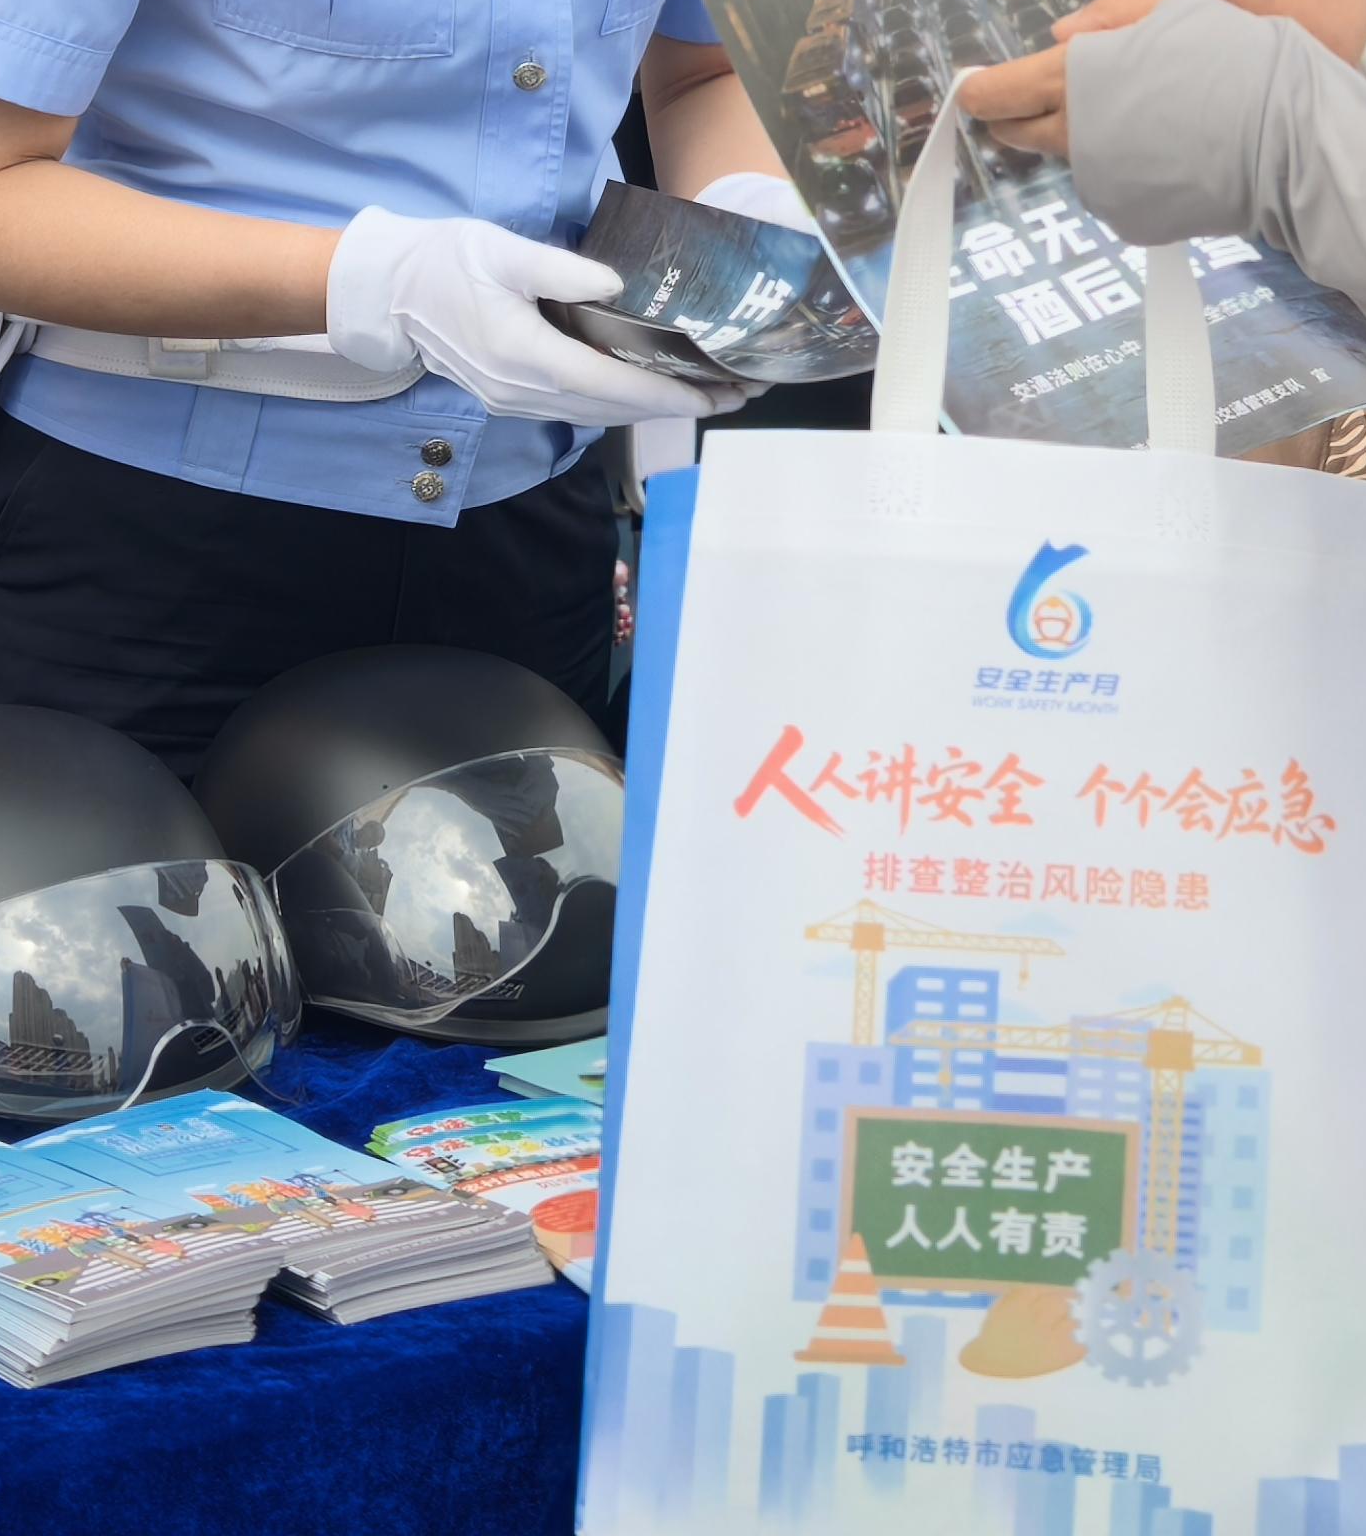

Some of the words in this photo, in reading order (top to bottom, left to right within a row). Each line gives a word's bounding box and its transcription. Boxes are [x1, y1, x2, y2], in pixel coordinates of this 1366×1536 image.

[1009, 339, 1142, 404] 交通法则在心中
[974, 666, 1121, 697] 安全生产月
[732, 723, 1045, 838] 人人讲安全
[1075, 757, 1337, 855] 个个会应急
[862, 851, 1212, 911] 排查整治风险隐患
[891, 1142, 1093, 1195] 安全生产
[884, 1205, 1088, 1260] 人人有责
[844, 1432, 1164, 1485] 呼和浩特市应急管理局
